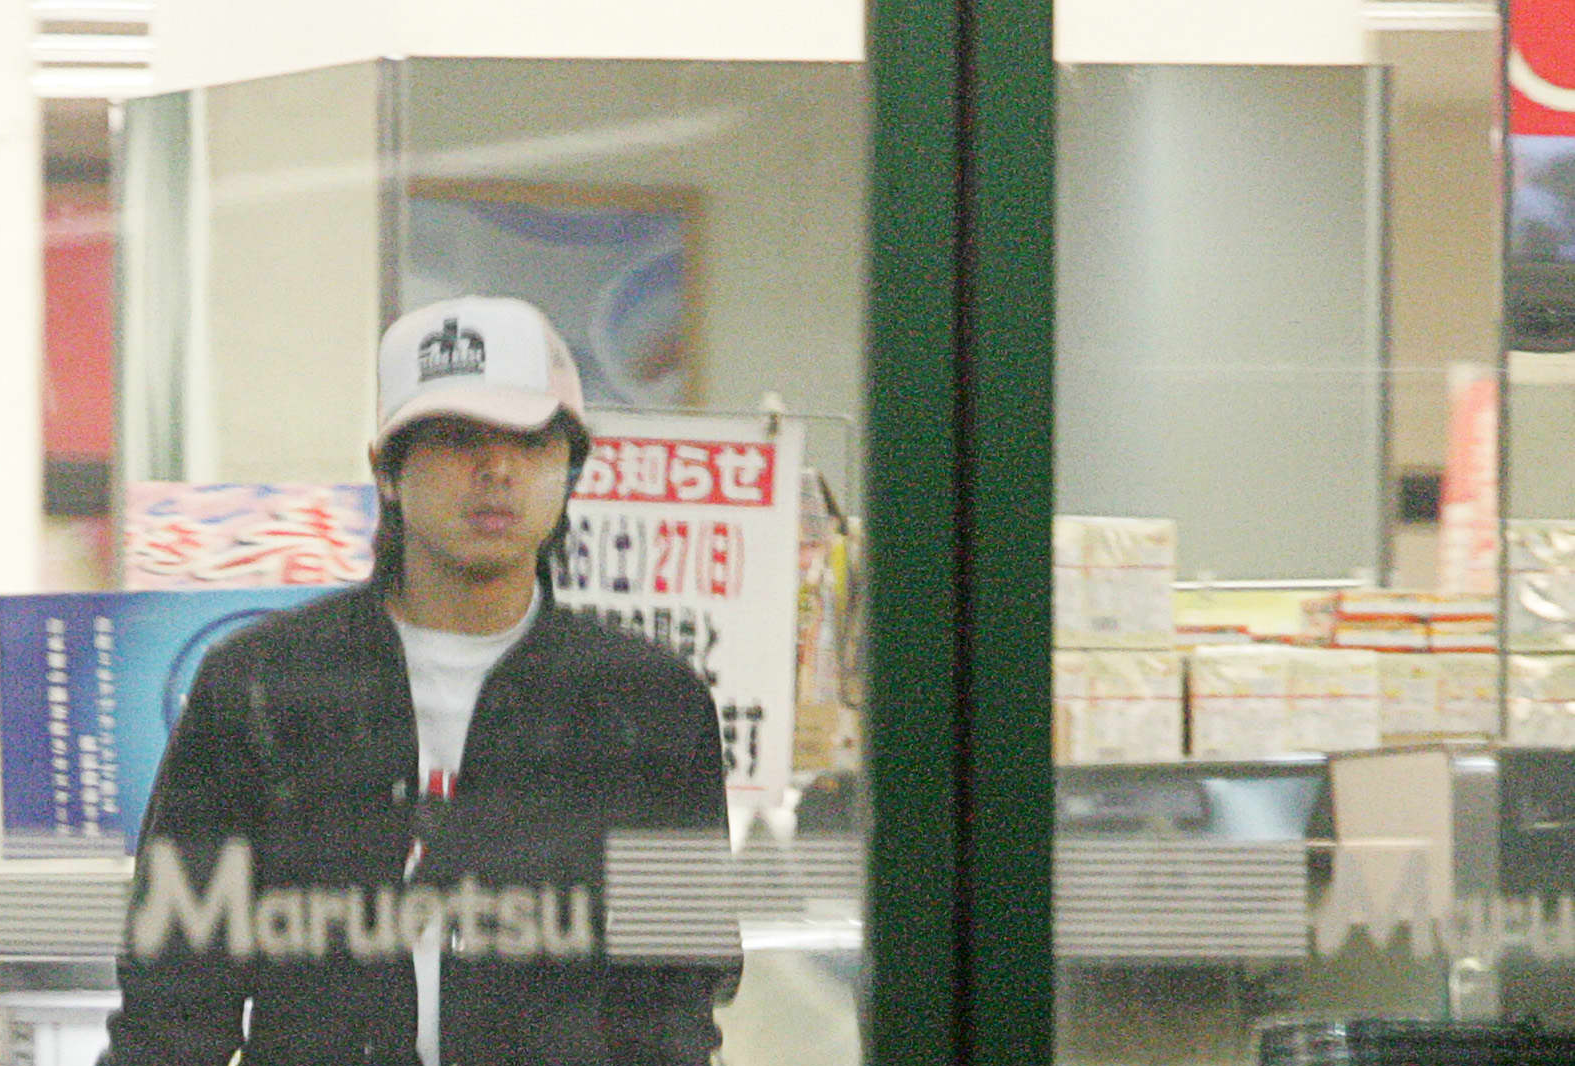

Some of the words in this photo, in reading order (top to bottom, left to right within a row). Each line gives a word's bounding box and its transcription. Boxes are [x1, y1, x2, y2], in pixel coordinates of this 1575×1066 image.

[577, 442, 766, 501] お知らせ
[131, 838, 594, 957] Maruetsu
